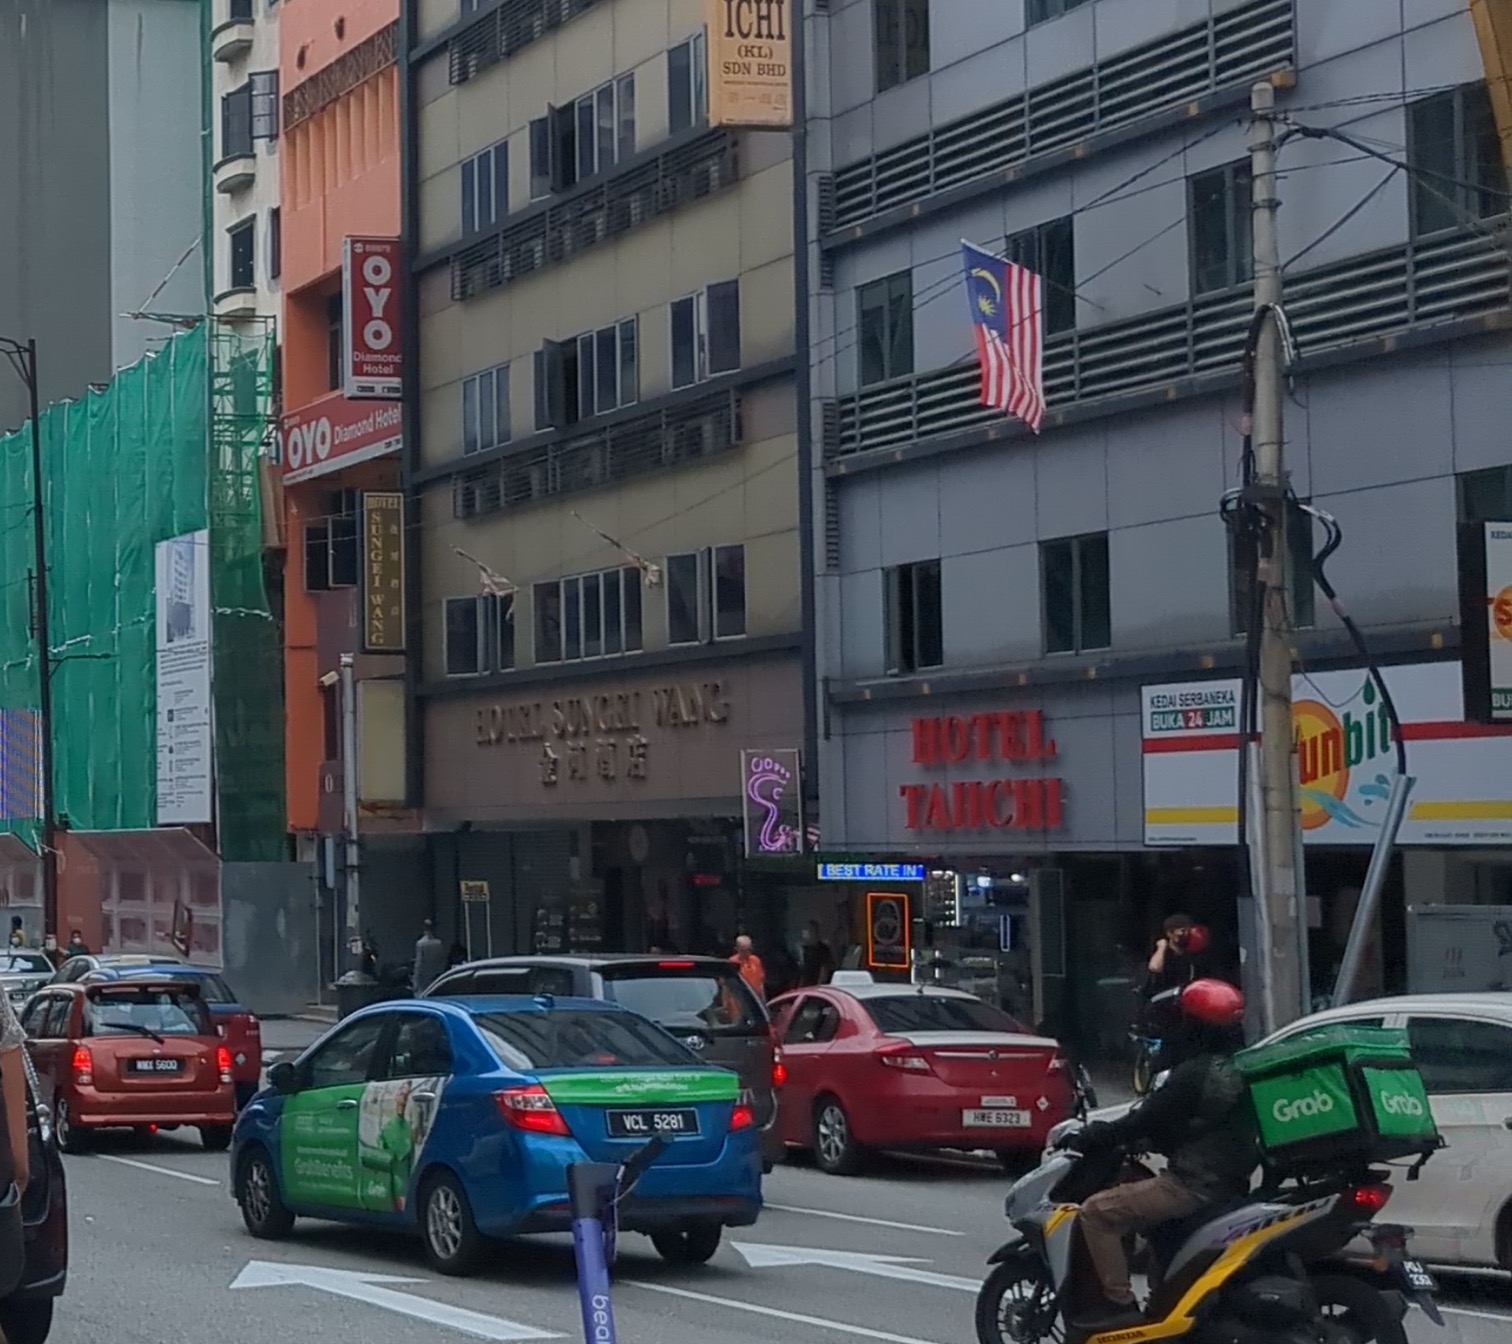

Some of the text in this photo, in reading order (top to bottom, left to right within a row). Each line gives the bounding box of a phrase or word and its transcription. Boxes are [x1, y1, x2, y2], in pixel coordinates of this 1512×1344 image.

[737, 45, 774, 61] (KL)
[722, 61, 787, 77] SDN BHD
[363, 255, 392, 351] OYO
[363, 364, 394, 375] Hotel
[288, 416, 332, 470] OYO
[333, 417, 375, 446] Diamond
[374, 402, 402, 430] Hotel
[369, 511, 385, 645] SUNGEI WANG
[1150, 689, 1236, 708] KEDAI SERBANEKA
[1151, 708, 1234, 731] BUKA 24 JAM
[912, 709, 1056, 763] HOTEL
[1296, 700, 1391, 786] unbit
[826, 864, 917, 878] BEST RATE IN
[1272, 1089, 1335, 1123] Grab
[1380, 1090, 1424, 1117] Grab
[622, 1113, 684, 1130] VCL 5281
[1096, 1330, 1147, 1344] HONDA
